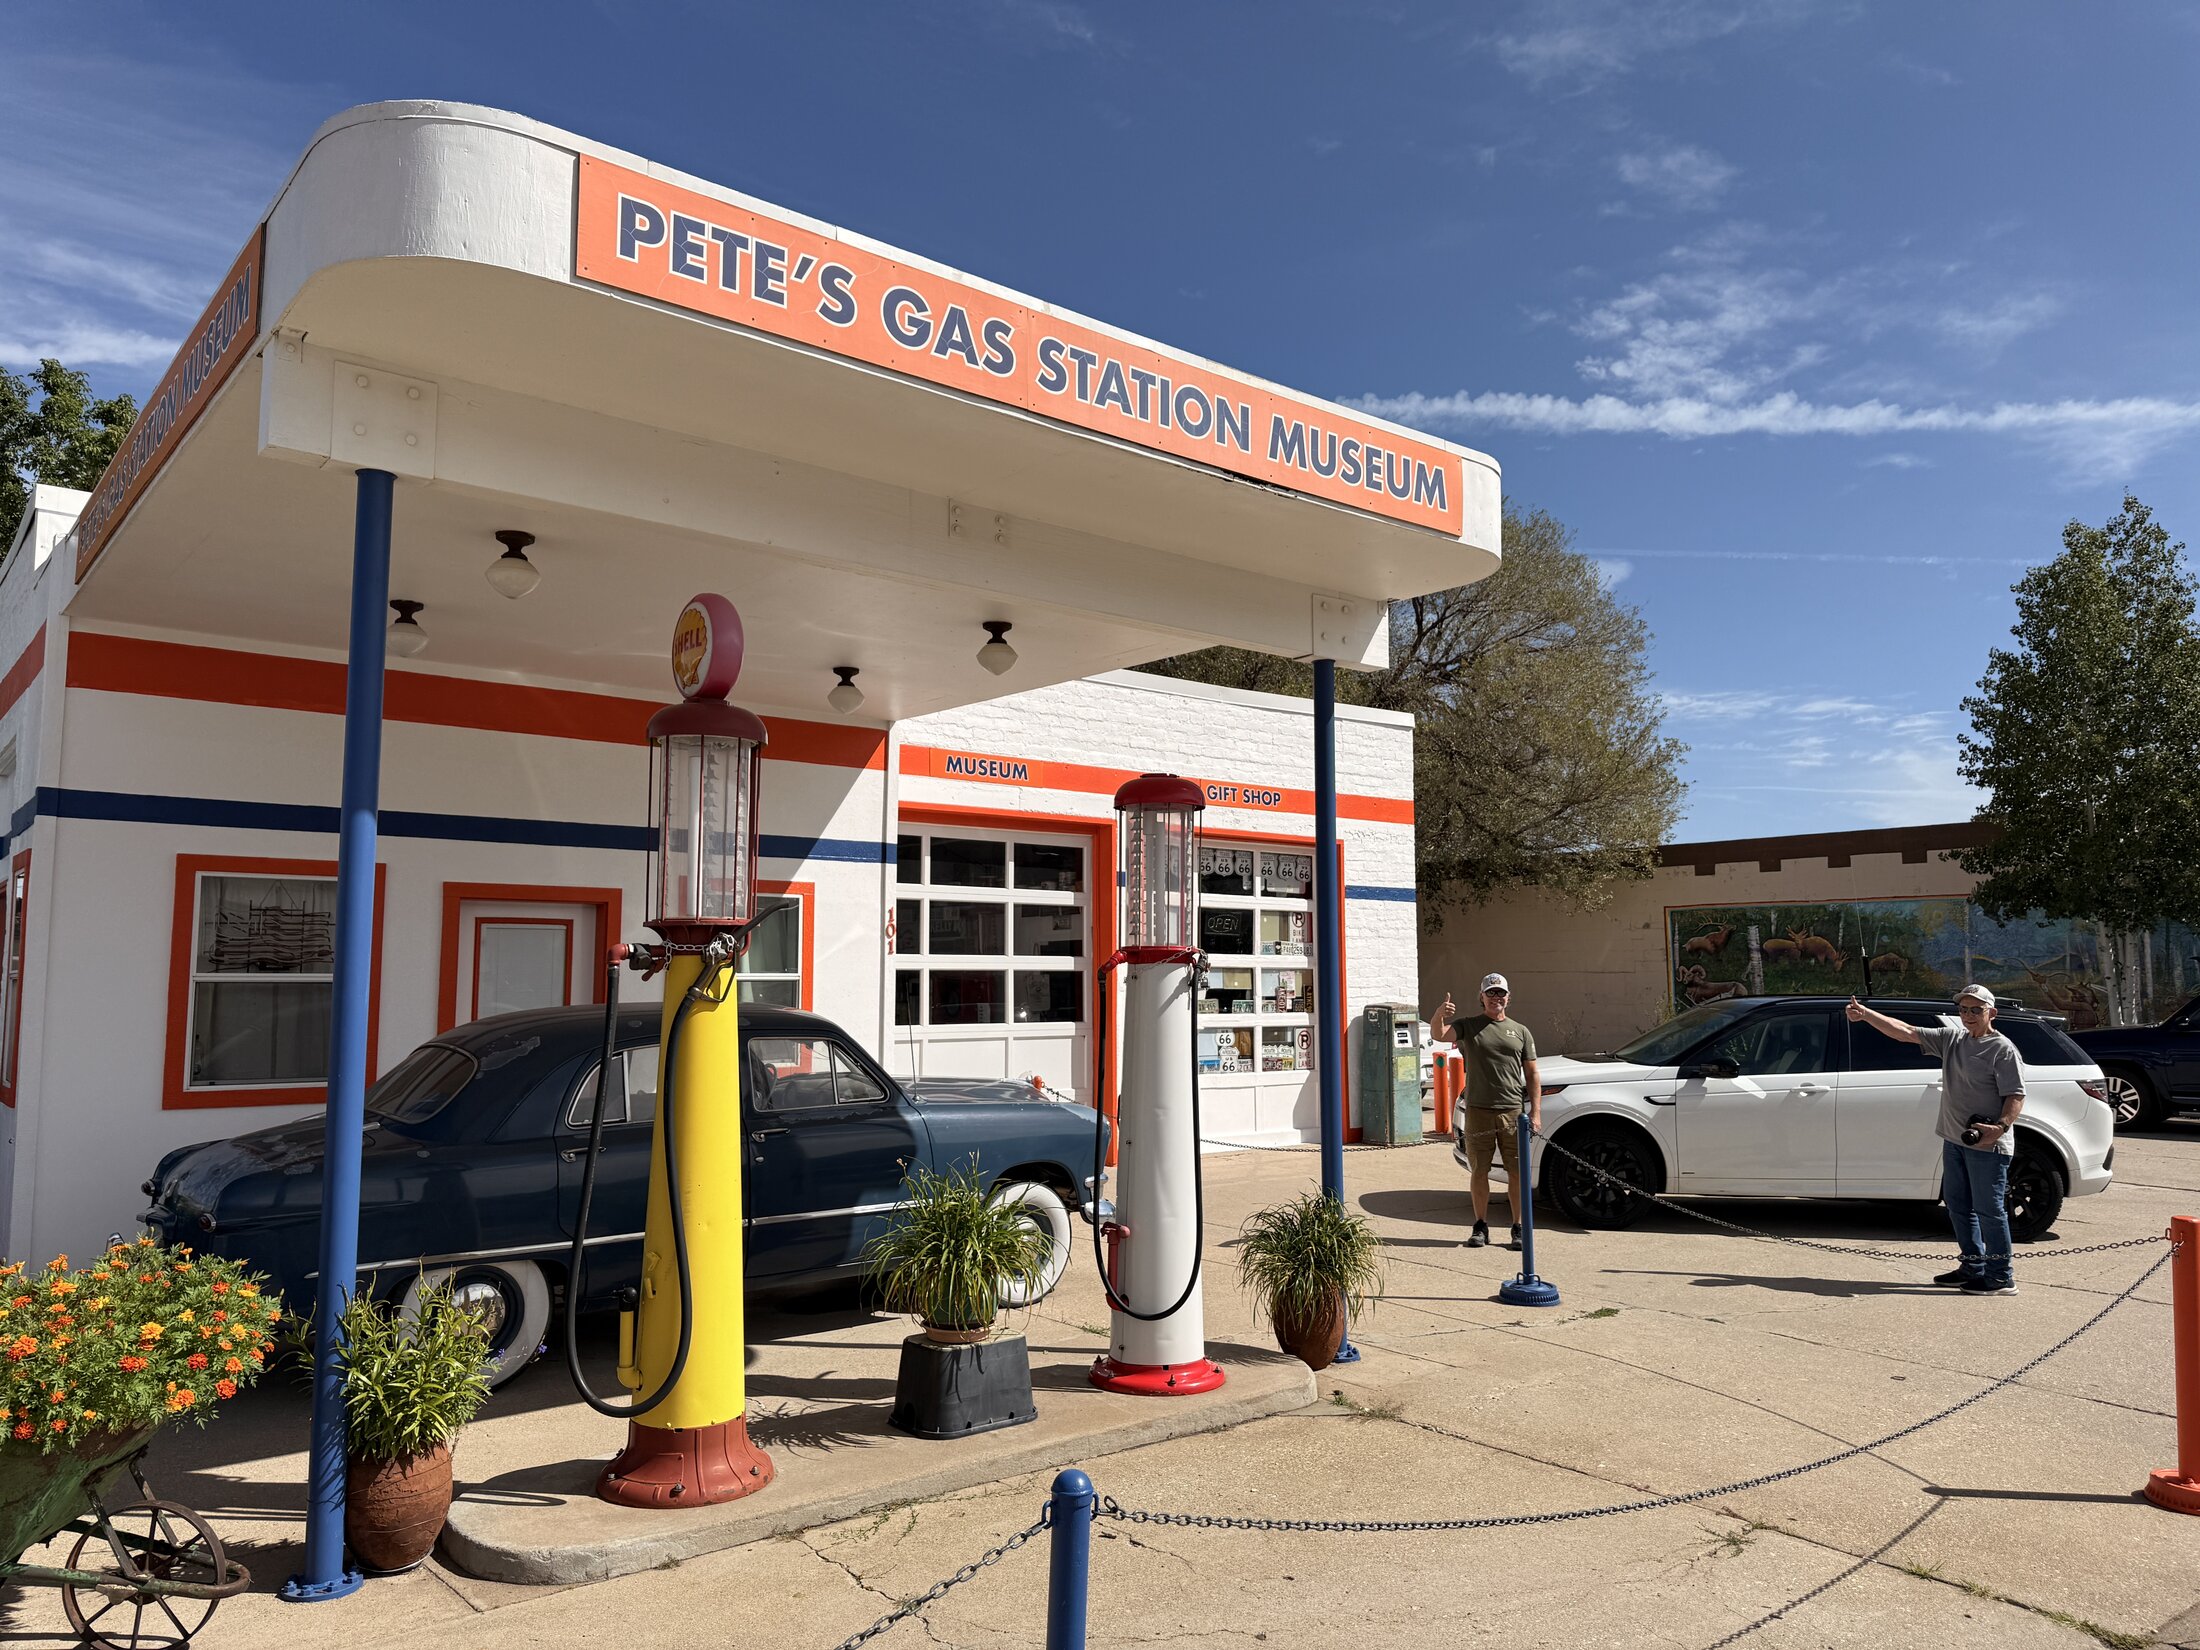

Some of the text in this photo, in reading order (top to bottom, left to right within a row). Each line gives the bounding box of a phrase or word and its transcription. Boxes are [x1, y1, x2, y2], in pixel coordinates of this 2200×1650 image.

[616, 192, 1448, 512] PETE'S GAS STATION MUSEUM
[106, 454, 127, 520] GAS
[127, 374, 179, 490] STATION
[179, 263, 251, 416] MUSEUM
[674, 627, 702, 656] SHELL
[945, 755, 1028, 780] MUSEUM
[1206, 785, 1281, 806] GIFT SHOP
[1199, 861, 1211, 871] 66
[1218, 863, 1230, 872] 66
[1239, 864, 1250, 873] 66
[1261, 866, 1273, 875] 66
[1282, 867, 1293, 877] 66
[1299, 870, 1310, 880] 66
[1207, 917, 1239, 931] OPEN
[886, 906, 896, 956] 101
[1292, 929, 1305, 937] BIKE
[1219, 1034, 1231, 1044] 66
[1298, 1051, 1311, 1059] BIKE
[1222, 1061, 1236, 1071] 66
[1298, 1060, 1312, 1068] LANE
